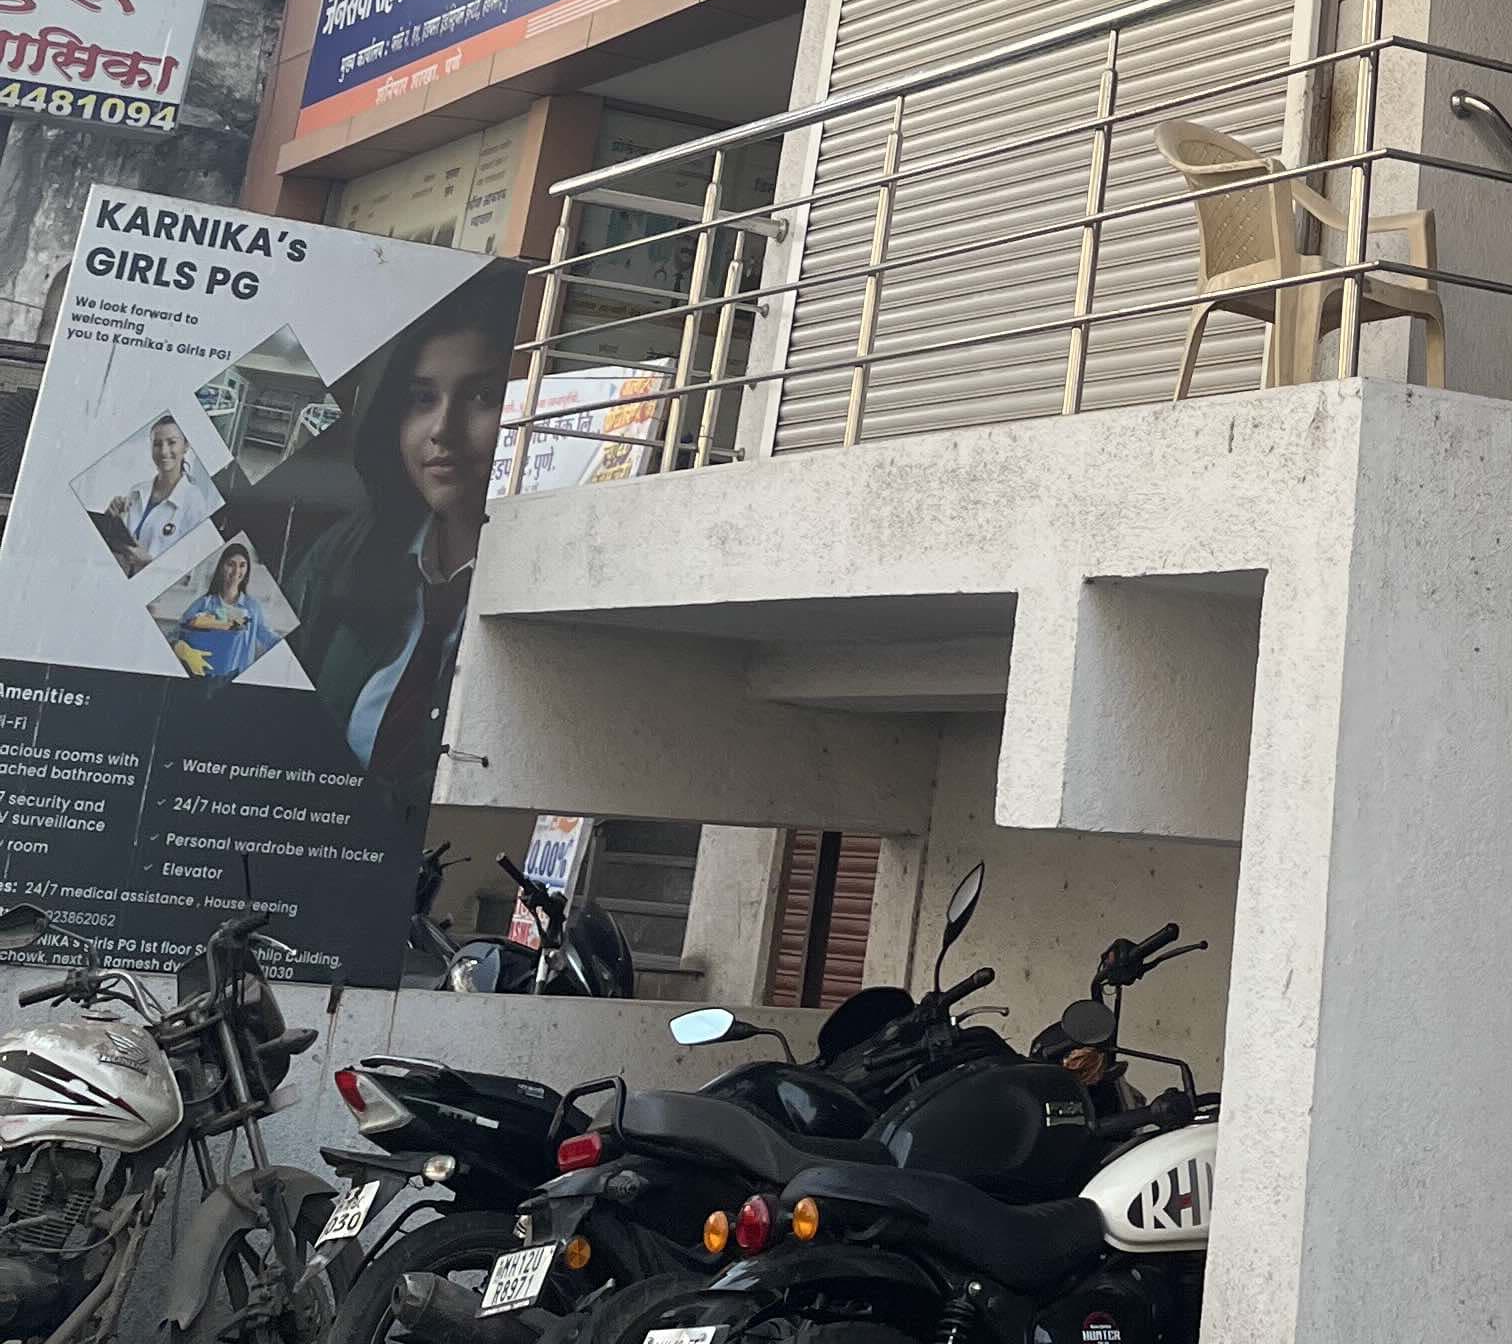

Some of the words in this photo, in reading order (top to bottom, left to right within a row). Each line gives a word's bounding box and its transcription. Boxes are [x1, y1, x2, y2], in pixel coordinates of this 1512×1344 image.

[85, 246, 198, 291] GIRLS
[205, 265, 260, 301] PG
[75, 295, 97, 309] We
[99, 299, 129, 314] look
[130, 303, 182, 323] forward
[185, 312, 199, 325] to
[71, 311, 145, 335] welcoming
[67, 327, 92, 340] you
[96, 330, 110, 343] to
[176, 342, 206, 358] Girls
[0, 682, 91, 707] Amenities:
[0, 743, 50, 760] acious
[54, 749, 104, 764] rooms
[107, 752, 140, 768] with
[0, 762, 48, 778] ached
[50, 765, 136, 786] bathrooms
[182, 759, 227, 775] Water
[229, 763, 283, 780] purifier
[285, 770, 316, 784] with
[318, 773, 365, 788] cooler
[8, 793, 71, 813] security
[73, 799, 105, 813] and
[172, 795, 209, 815] 24/7
[211, 801, 237, 816] Hot
[239, 804, 269, 817] and
[272, 806, 307, 822] Cold
[309, 811, 351, 826] water
[11, 813, 106, 832] surveillance
[7, 840, 49, 854] room
[166, 832, 231, 851] Personal
[234, 840, 304, 857] wardrobe
[307, 845, 338, 859] with
[340, 847, 385, 863] locker
[162, 862, 224, 880] Elevator
[25, 879, 58, 898] 24/7
[60, 886, 118, 901] medical
[117, 938, 136, 952] PG
[161, 940, 192, 955] floor
[52, 953, 83, 965] next
[103, 955, 160, 970] Ramesh
[1082, 1330, 1121, 1342] HUNTER
